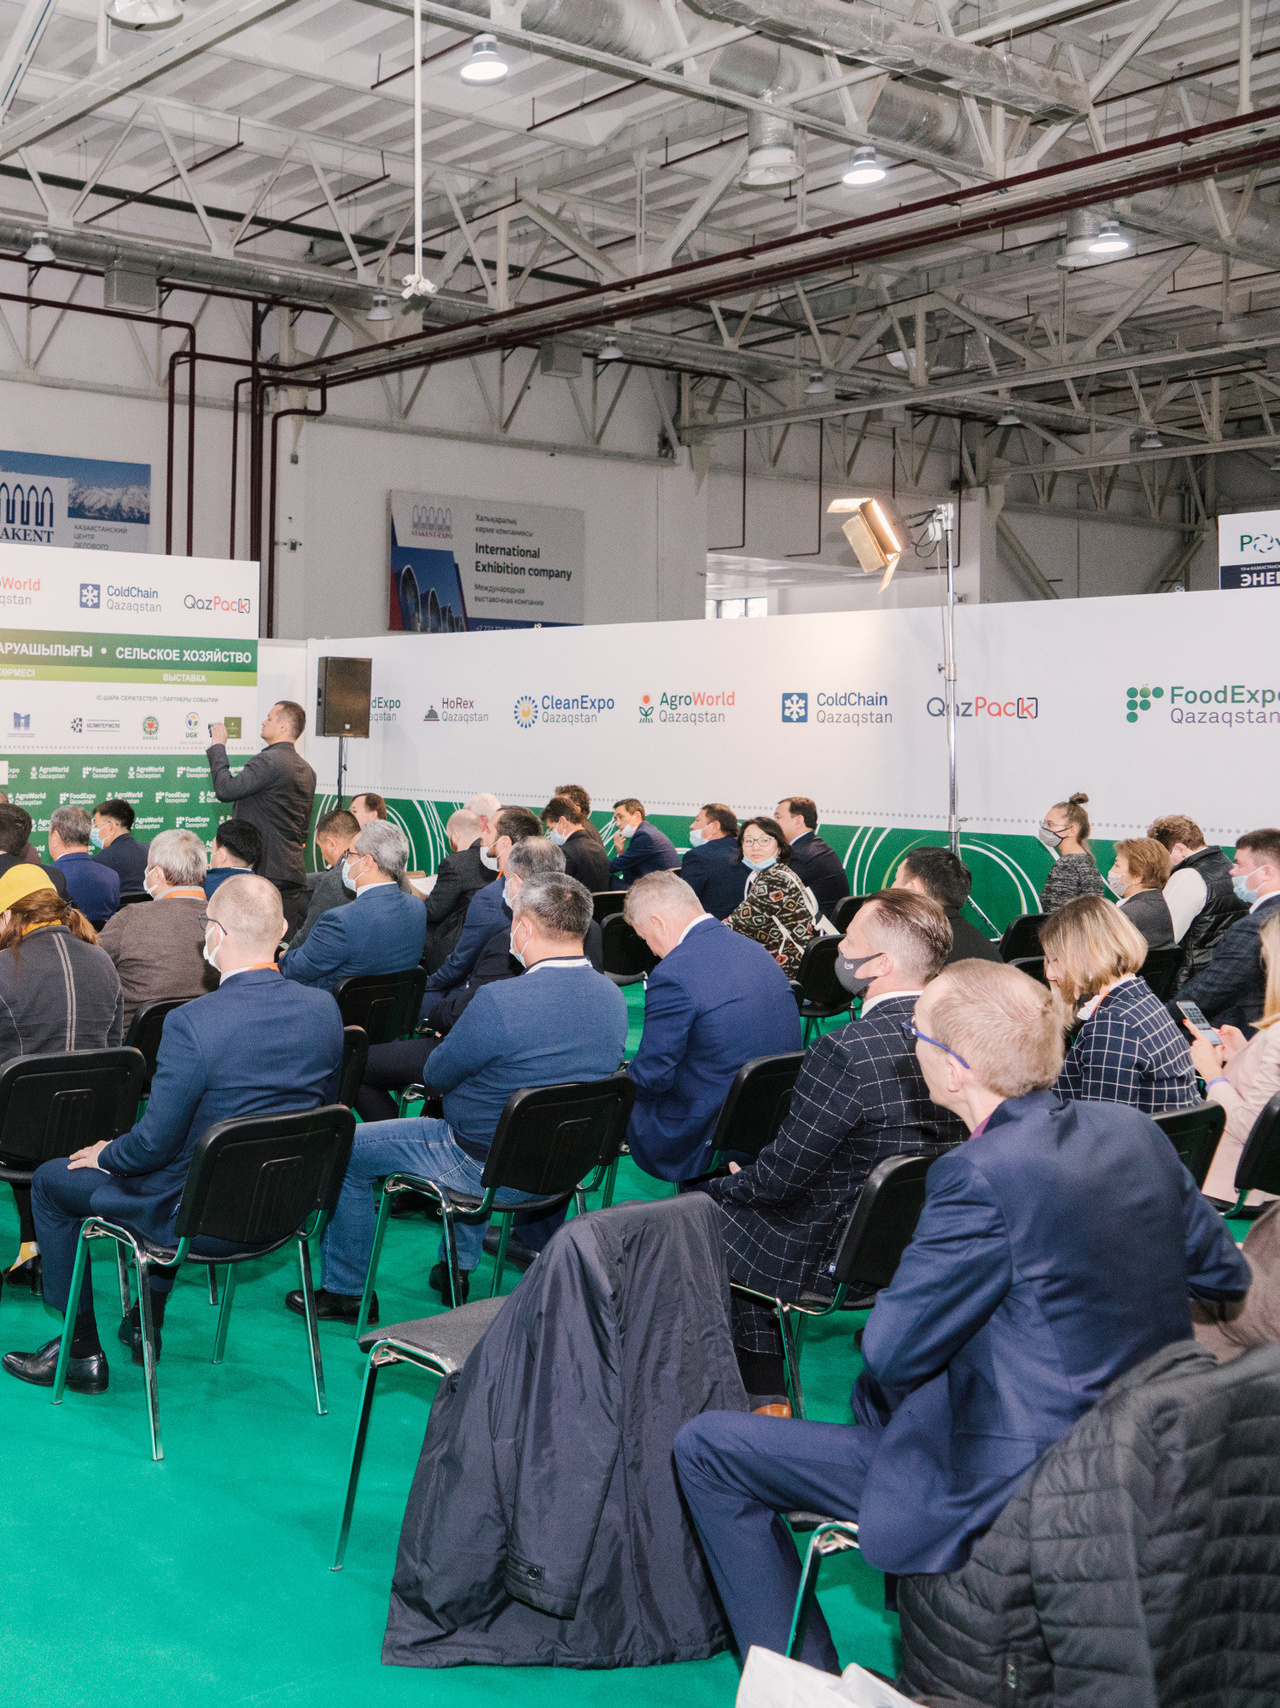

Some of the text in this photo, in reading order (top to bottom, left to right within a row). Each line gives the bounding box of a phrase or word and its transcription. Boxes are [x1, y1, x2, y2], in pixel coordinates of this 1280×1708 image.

[475, 542, 540, 559] International
[475, 561, 572, 582] Exhibition company
[106, 585, 159, 599] ColdChain
[106, 598, 162, 613] Qazaqstan
[116, 646, 180, 662] СЕЛЬСКОЕ
[183, 647, 252, 664] ХОЗЯЙСТВО
[162, 672, 206, 683] ВЫСТАВКА
[370, 697, 401, 711] dExpo
[442, 698, 474, 709] HoRex
[660, 692, 736, 710] AgroWorld
[817, 692, 888, 706] ColdChain
[1170, 685, 1280, 708] FoodExp
[541, 696, 615, 714] CleanExpo
[442, 711, 489, 724] Qazaqstan
[542, 712, 598, 725] Qazaqstan
[658, 709, 726, 726] Qazaqstan
[816, 710, 892, 726] Qazaqstan
[1170, 708, 1280, 727] Qazaqstan
